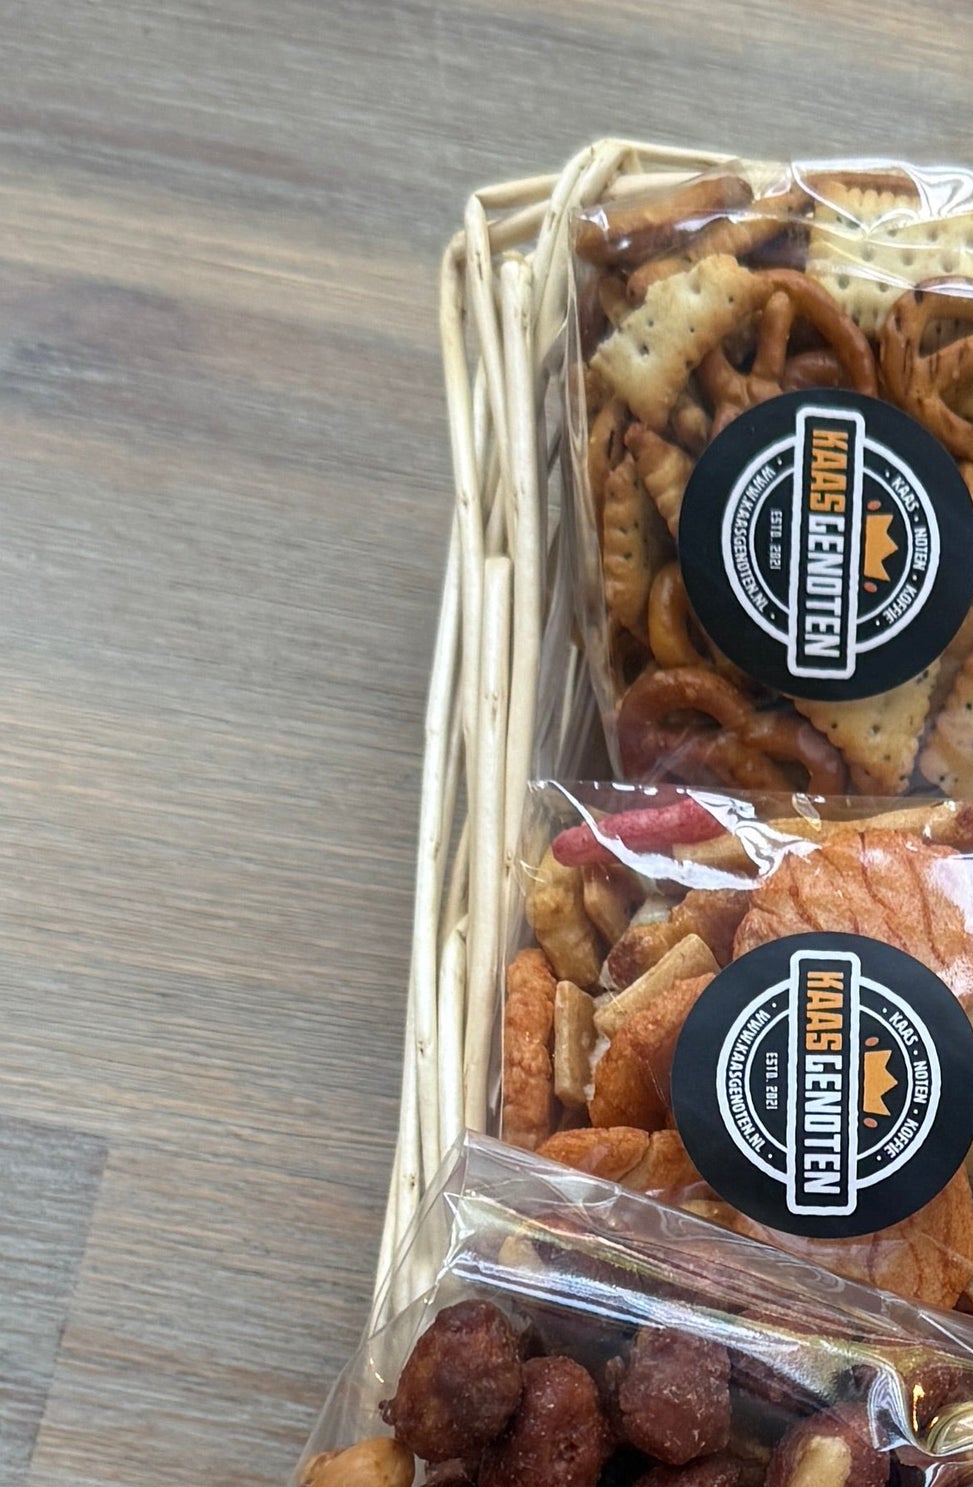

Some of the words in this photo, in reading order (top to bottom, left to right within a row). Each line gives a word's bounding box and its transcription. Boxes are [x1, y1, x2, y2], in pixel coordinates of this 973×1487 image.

[892, 476, 919, 514] KAAS
[733, 466, 776, 614] WWW.KAASGENOTEN.NL
[769, 545, 782, 570] 2021
[804, 429, 849, 658] KAASGENOTEN
[913, 526, 929, 571] NOTEN
[884, 587, 918, 624] KOFFIE
[888, 1011, 918, 1047] KAAS
[726, 1009, 771, 1153] WWW.KAASGENOTEN.NL
[765, 1086, 778, 1110] 2021
[803, 971, 844, 1194] KAASGENOTEN
[913, 1060, 929, 1104] NOTEN
[885, 1118, 919, 1159] KOFFIE
